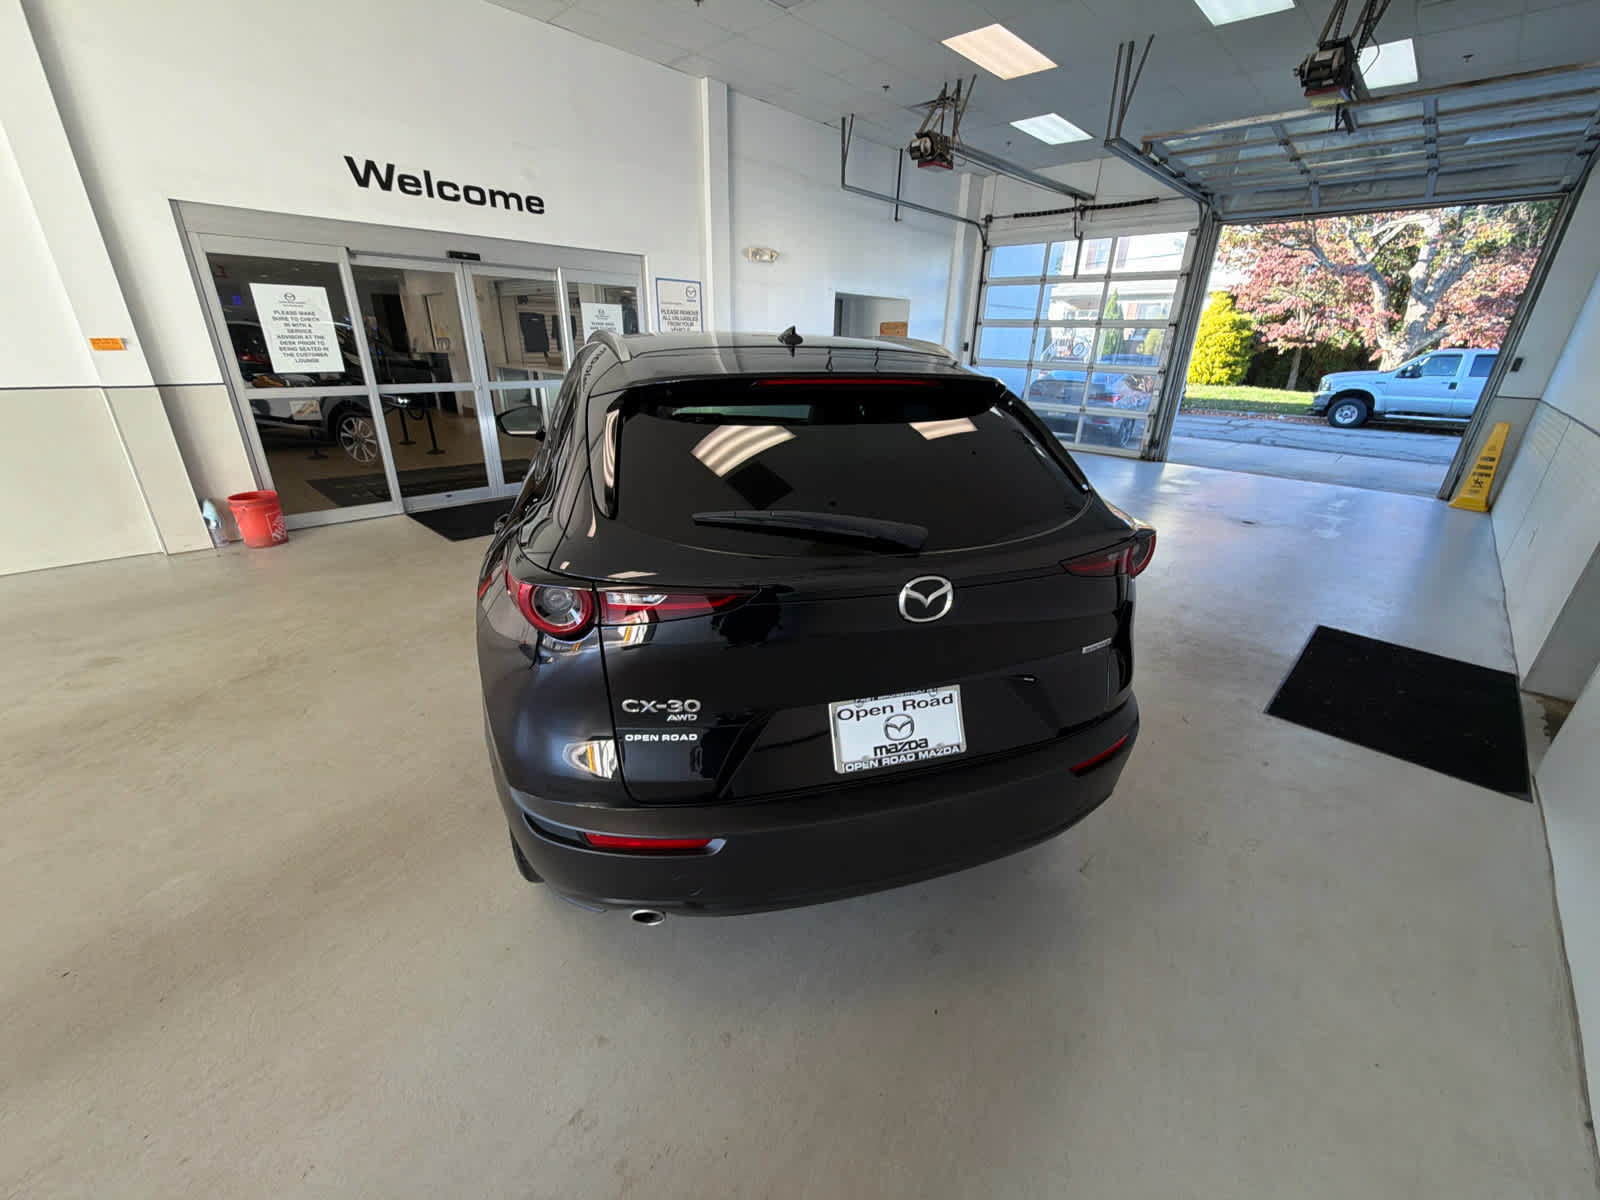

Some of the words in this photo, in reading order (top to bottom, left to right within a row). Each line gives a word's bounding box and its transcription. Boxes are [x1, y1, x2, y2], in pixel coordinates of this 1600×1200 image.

[343, 155, 545, 215] Welcome
[621, 699, 701, 713] CX-30
[836, 702, 894, 721] Open
[902, 693, 953, 711] Road
[666, 714, 698, 722] AWD
[624, 734, 659, 742] OPEN
[661, 733, 698, 742] ROAD
[873, 737, 929, 757] mazda
[844, 760, 879, 773] OPEN
[882, 751, 916, 766] ROAD
[918, 744, 960, 760] MAZDA
